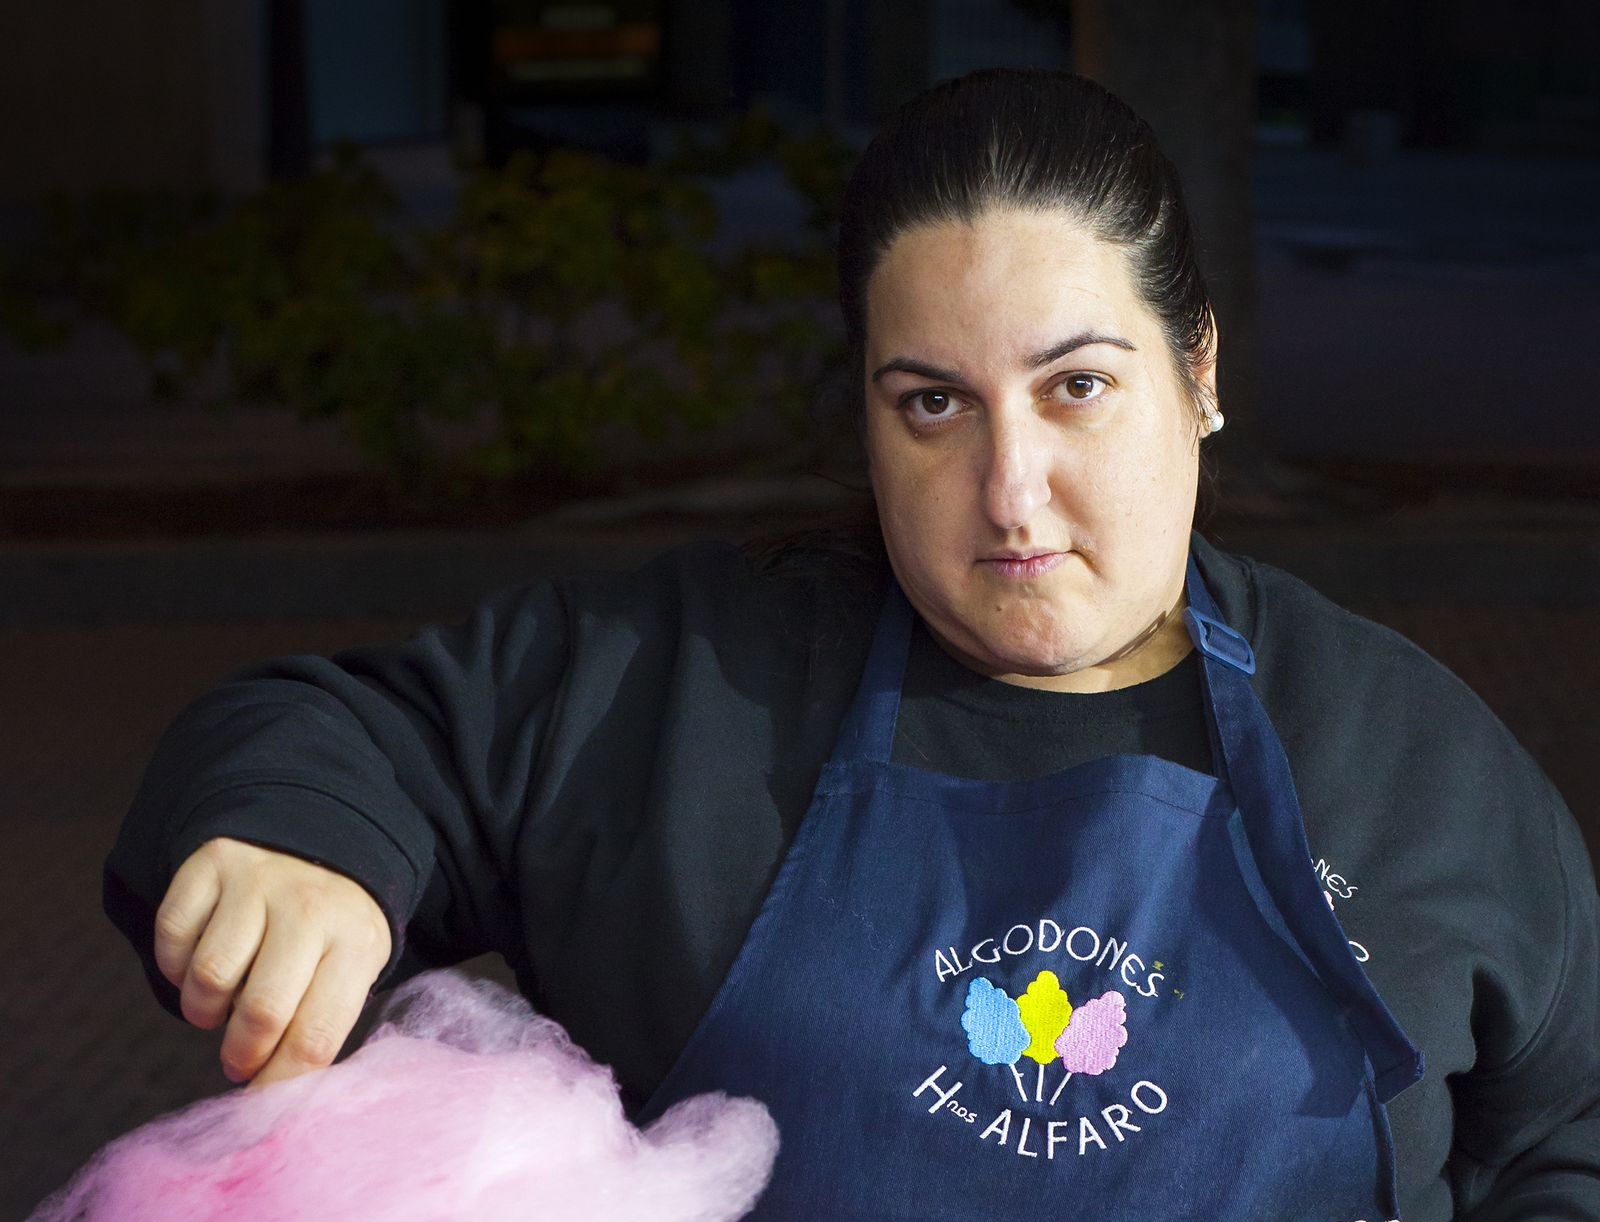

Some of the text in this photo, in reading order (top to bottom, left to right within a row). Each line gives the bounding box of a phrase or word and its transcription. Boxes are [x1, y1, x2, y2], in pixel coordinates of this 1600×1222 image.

[1311, 858, 1359, 899] NES
[934, 918, 1165, 998] ALGODONES
[979, 1080, 1168, 1160] ALFARO
